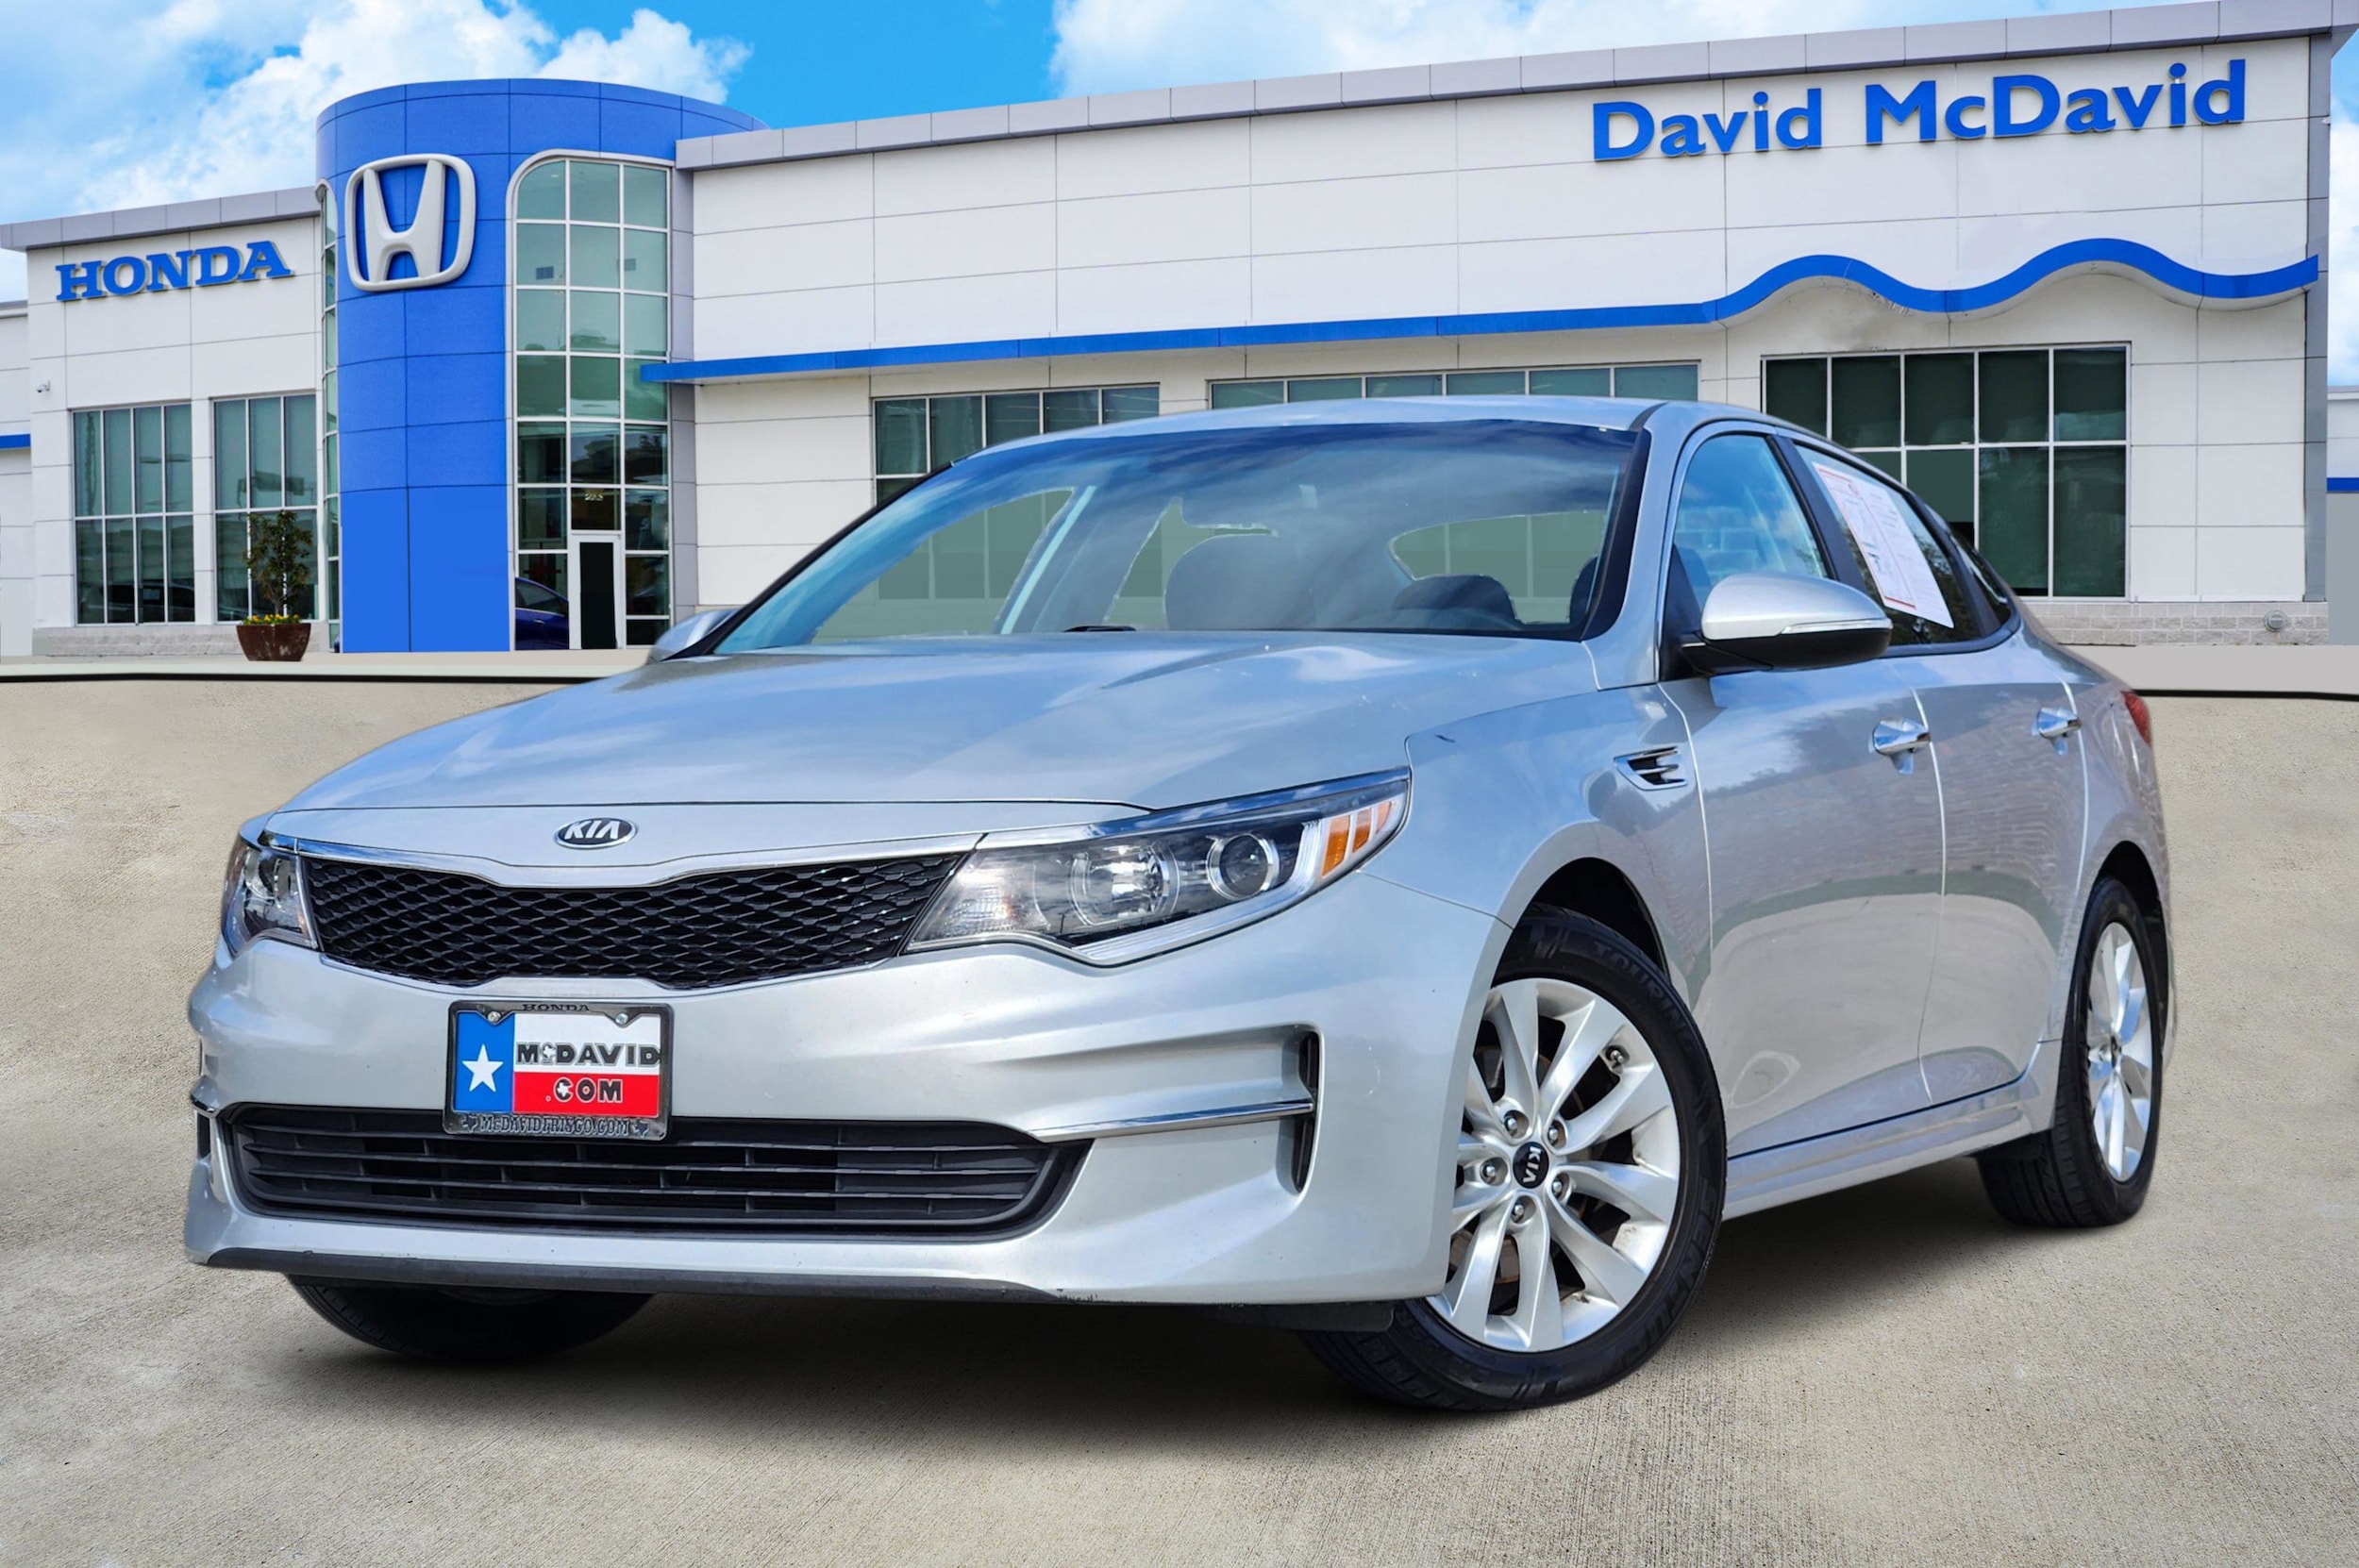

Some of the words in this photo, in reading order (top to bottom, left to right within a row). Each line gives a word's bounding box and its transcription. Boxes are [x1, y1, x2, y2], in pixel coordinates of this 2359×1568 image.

[1593, 88, 1822, 161] David
[1865, 58, 2246, 146] McDavid
[56, 240, 294, 302] HONDA
[564, 820, 621, 841] KIA
[522, 1003, 590, 1012] HONDA
[545, 1076, 623, 1103] .COM
[1522, 1146, 1542, 1183] KIA
